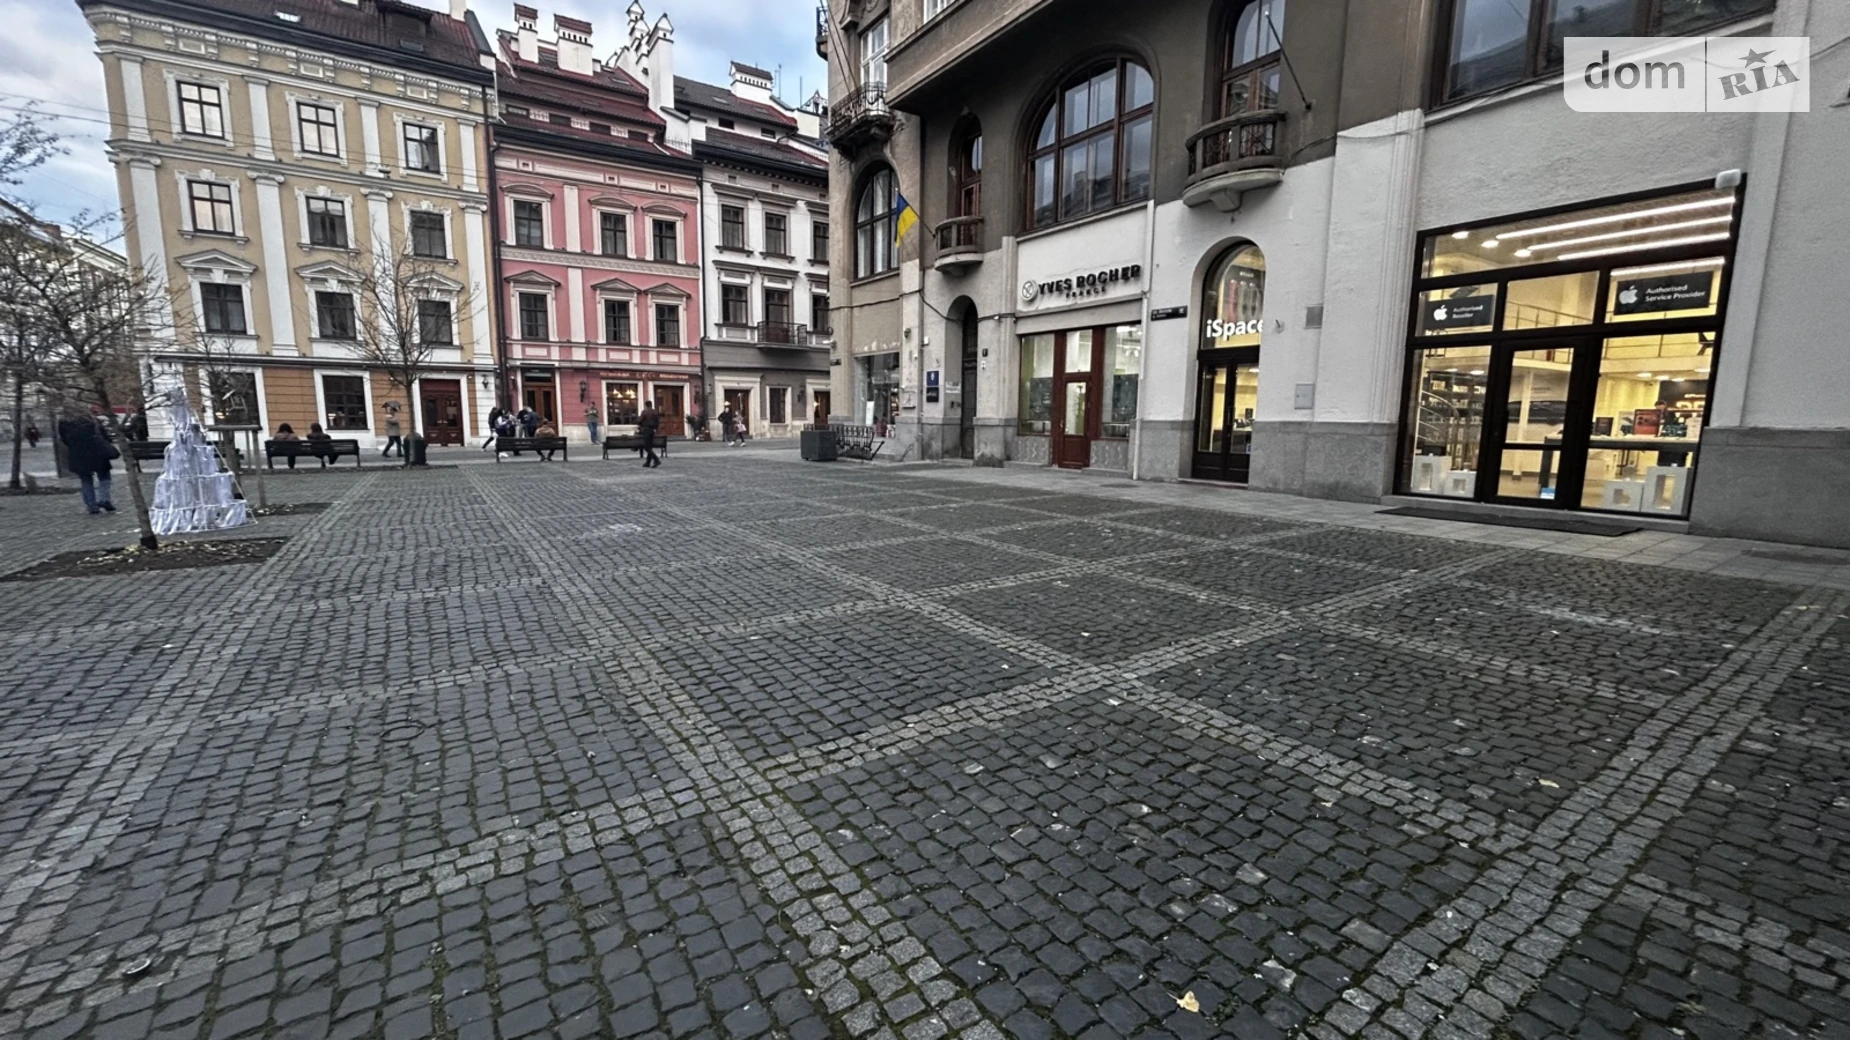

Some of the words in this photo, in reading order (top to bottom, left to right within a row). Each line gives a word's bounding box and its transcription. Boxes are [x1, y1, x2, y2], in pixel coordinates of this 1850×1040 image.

[1038, 278, 1072, 295] YVES
[1076, 264, 1141, 288] ROCHER
[1645, 284, 1688, 294] Authorised
[1645, 294, 1672, 302] Service
[1673, 290, 1706, 299] Provider
[1453, 304, 1483, 313] Authorised
